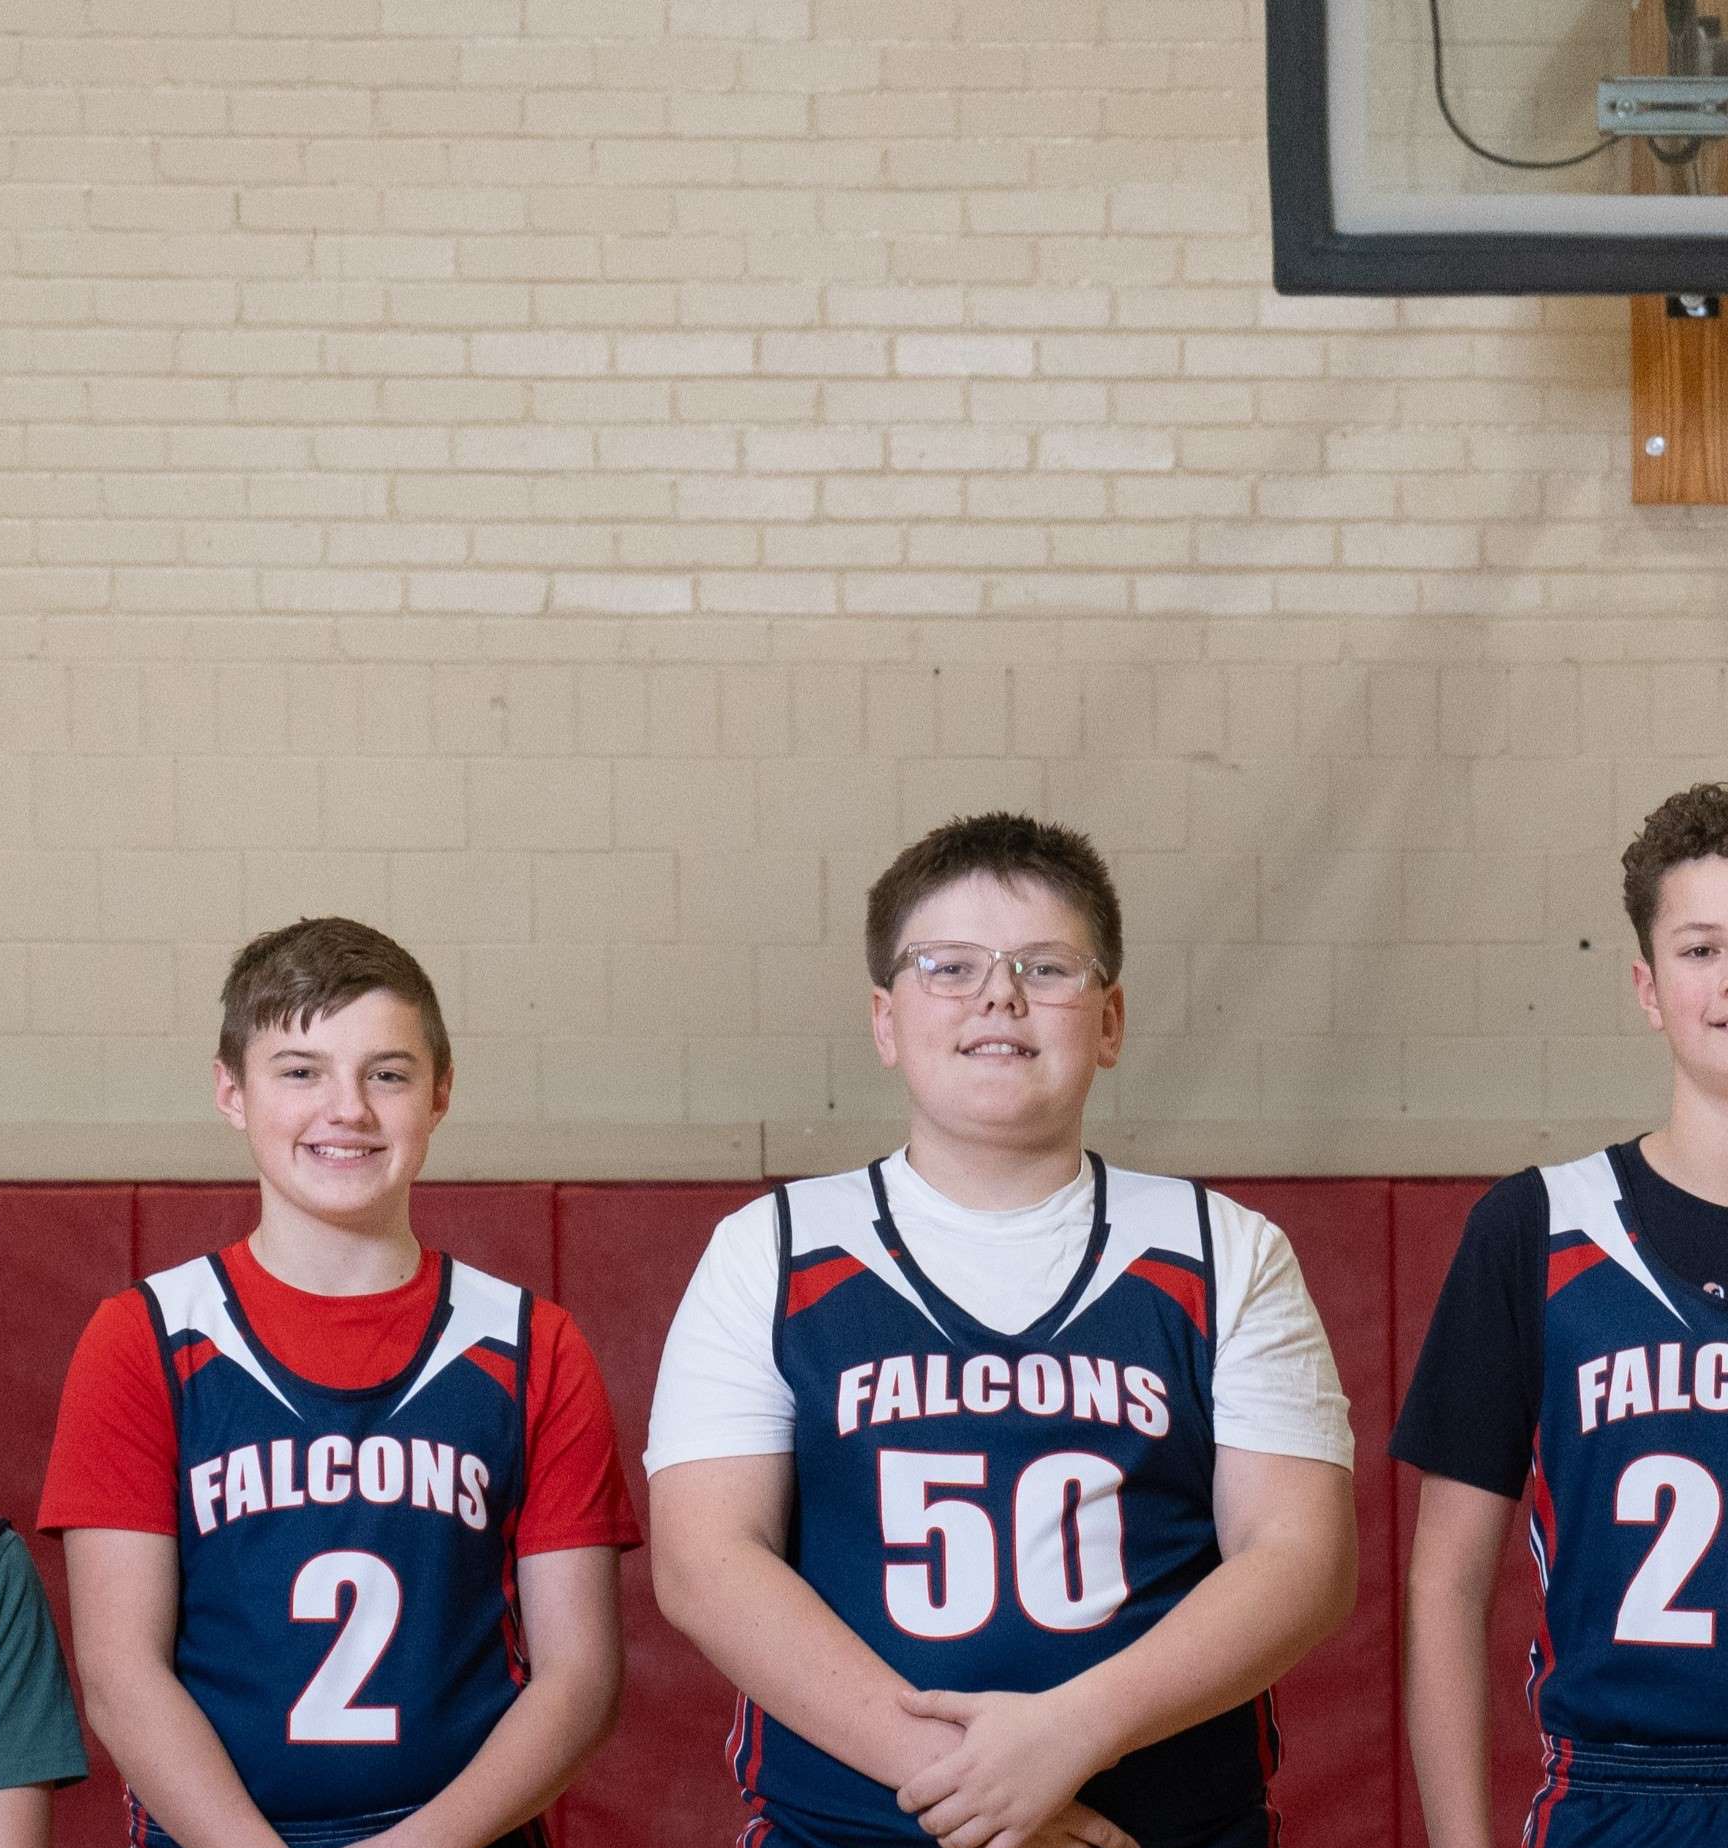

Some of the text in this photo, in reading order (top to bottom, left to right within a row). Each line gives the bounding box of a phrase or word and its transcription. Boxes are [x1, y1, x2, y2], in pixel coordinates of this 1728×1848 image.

[836, 1352, 1171, 1438] FALCONS
[188, 1434, 491, 1536] FALCONS
[876, 1447, 1132, 1643] 50
[285, 1549, 403, 1746] 2
